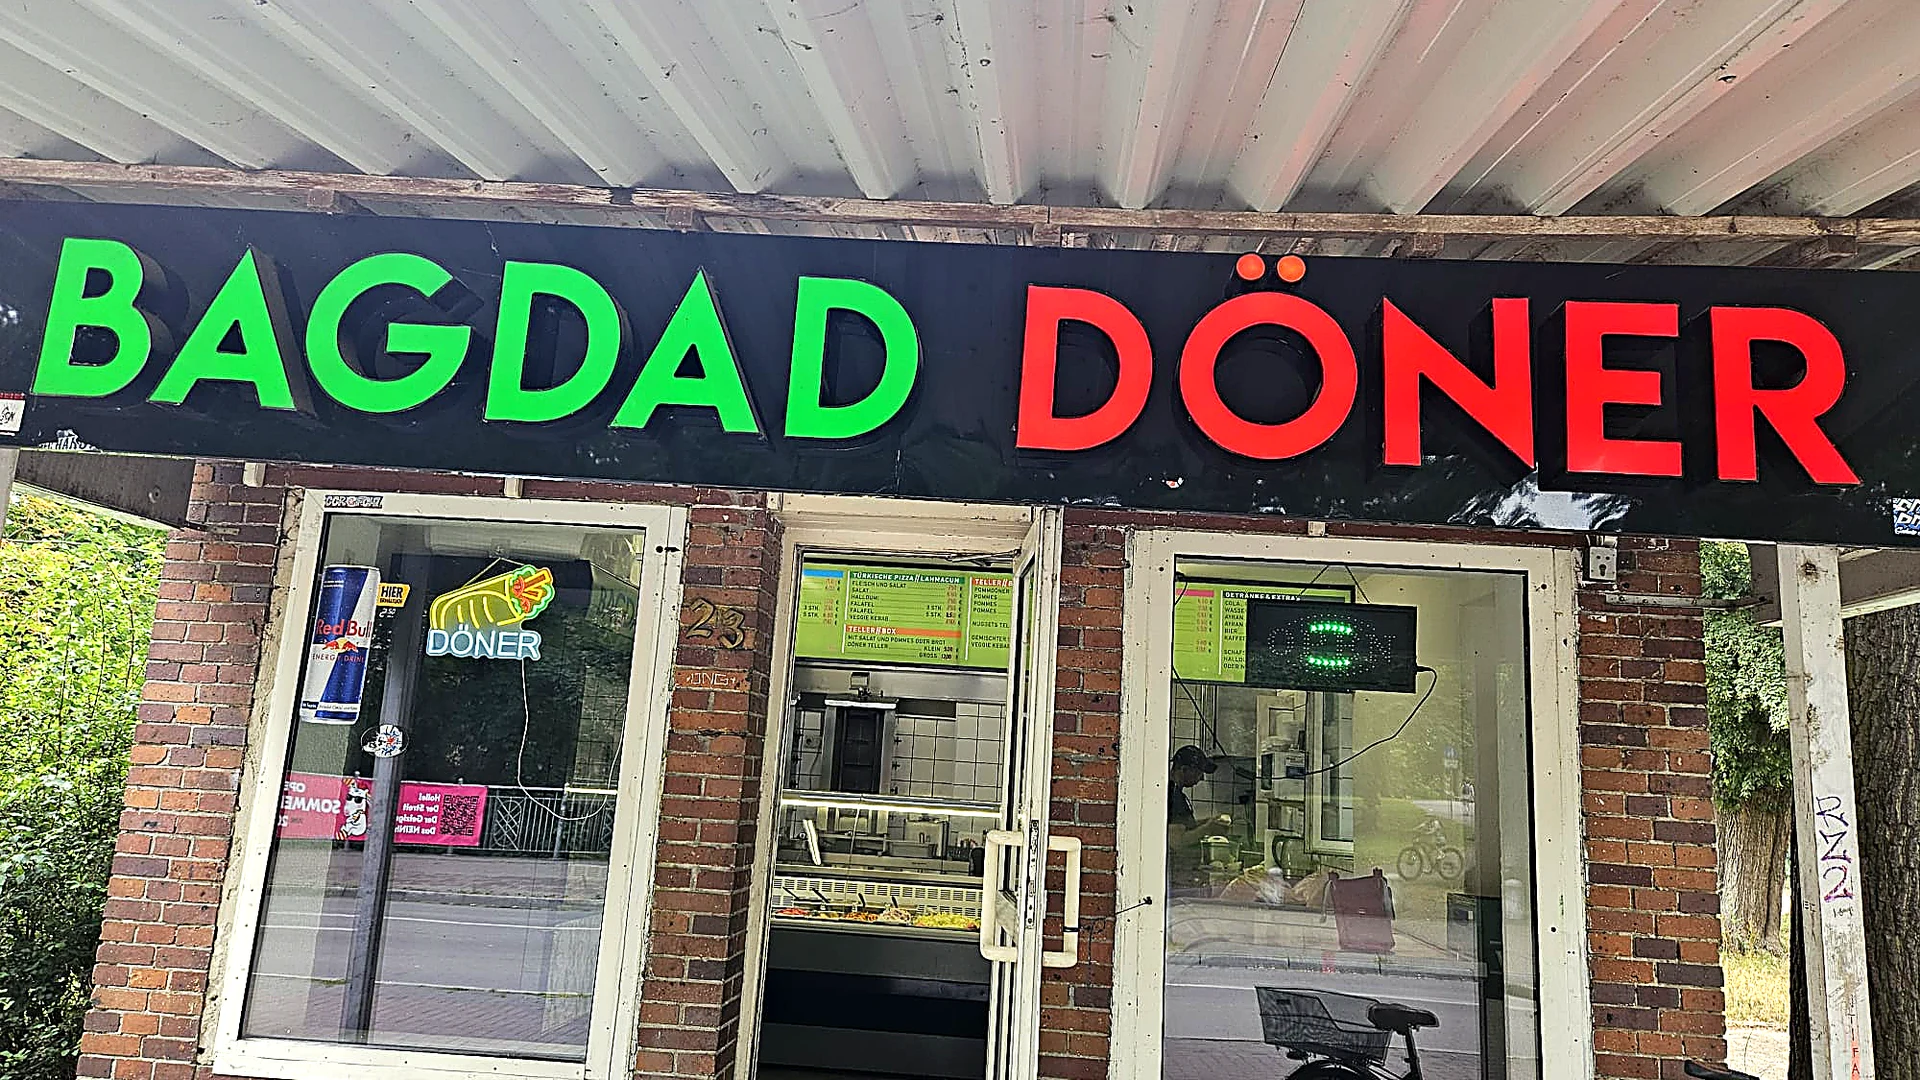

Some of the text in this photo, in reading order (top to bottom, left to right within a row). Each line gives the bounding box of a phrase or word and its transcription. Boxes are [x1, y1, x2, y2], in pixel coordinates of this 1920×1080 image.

[32, 237, 1860, 486] BAGDAD DÖNER
[380, 585, 404, 599] HIER
[316, 618, 373, 638] Red Bull
[427, 622, 543, 661] DÖNER
[686, 596, 746, 650] 23
